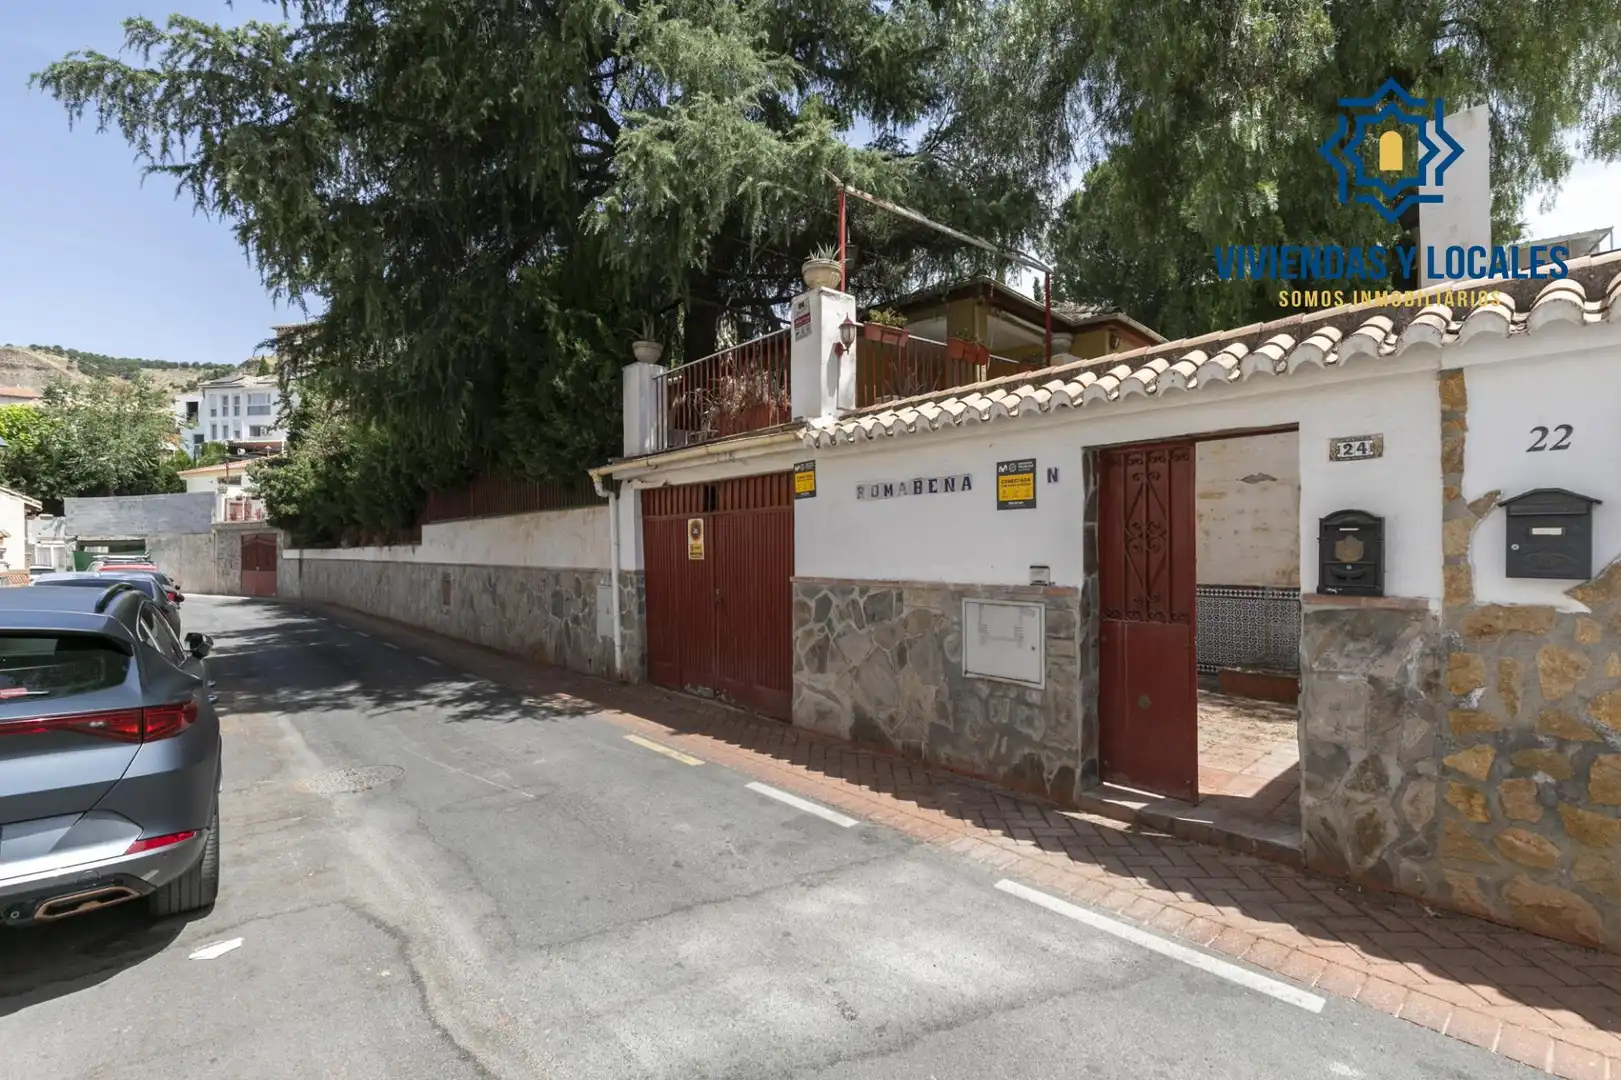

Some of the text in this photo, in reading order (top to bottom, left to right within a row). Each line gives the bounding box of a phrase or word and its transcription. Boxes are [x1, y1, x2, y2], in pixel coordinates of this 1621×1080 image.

[1526, 424, 1574, 452] 22
[1343, 442, 1368, 455] 24
[1047, 467, 1059, 483] N
